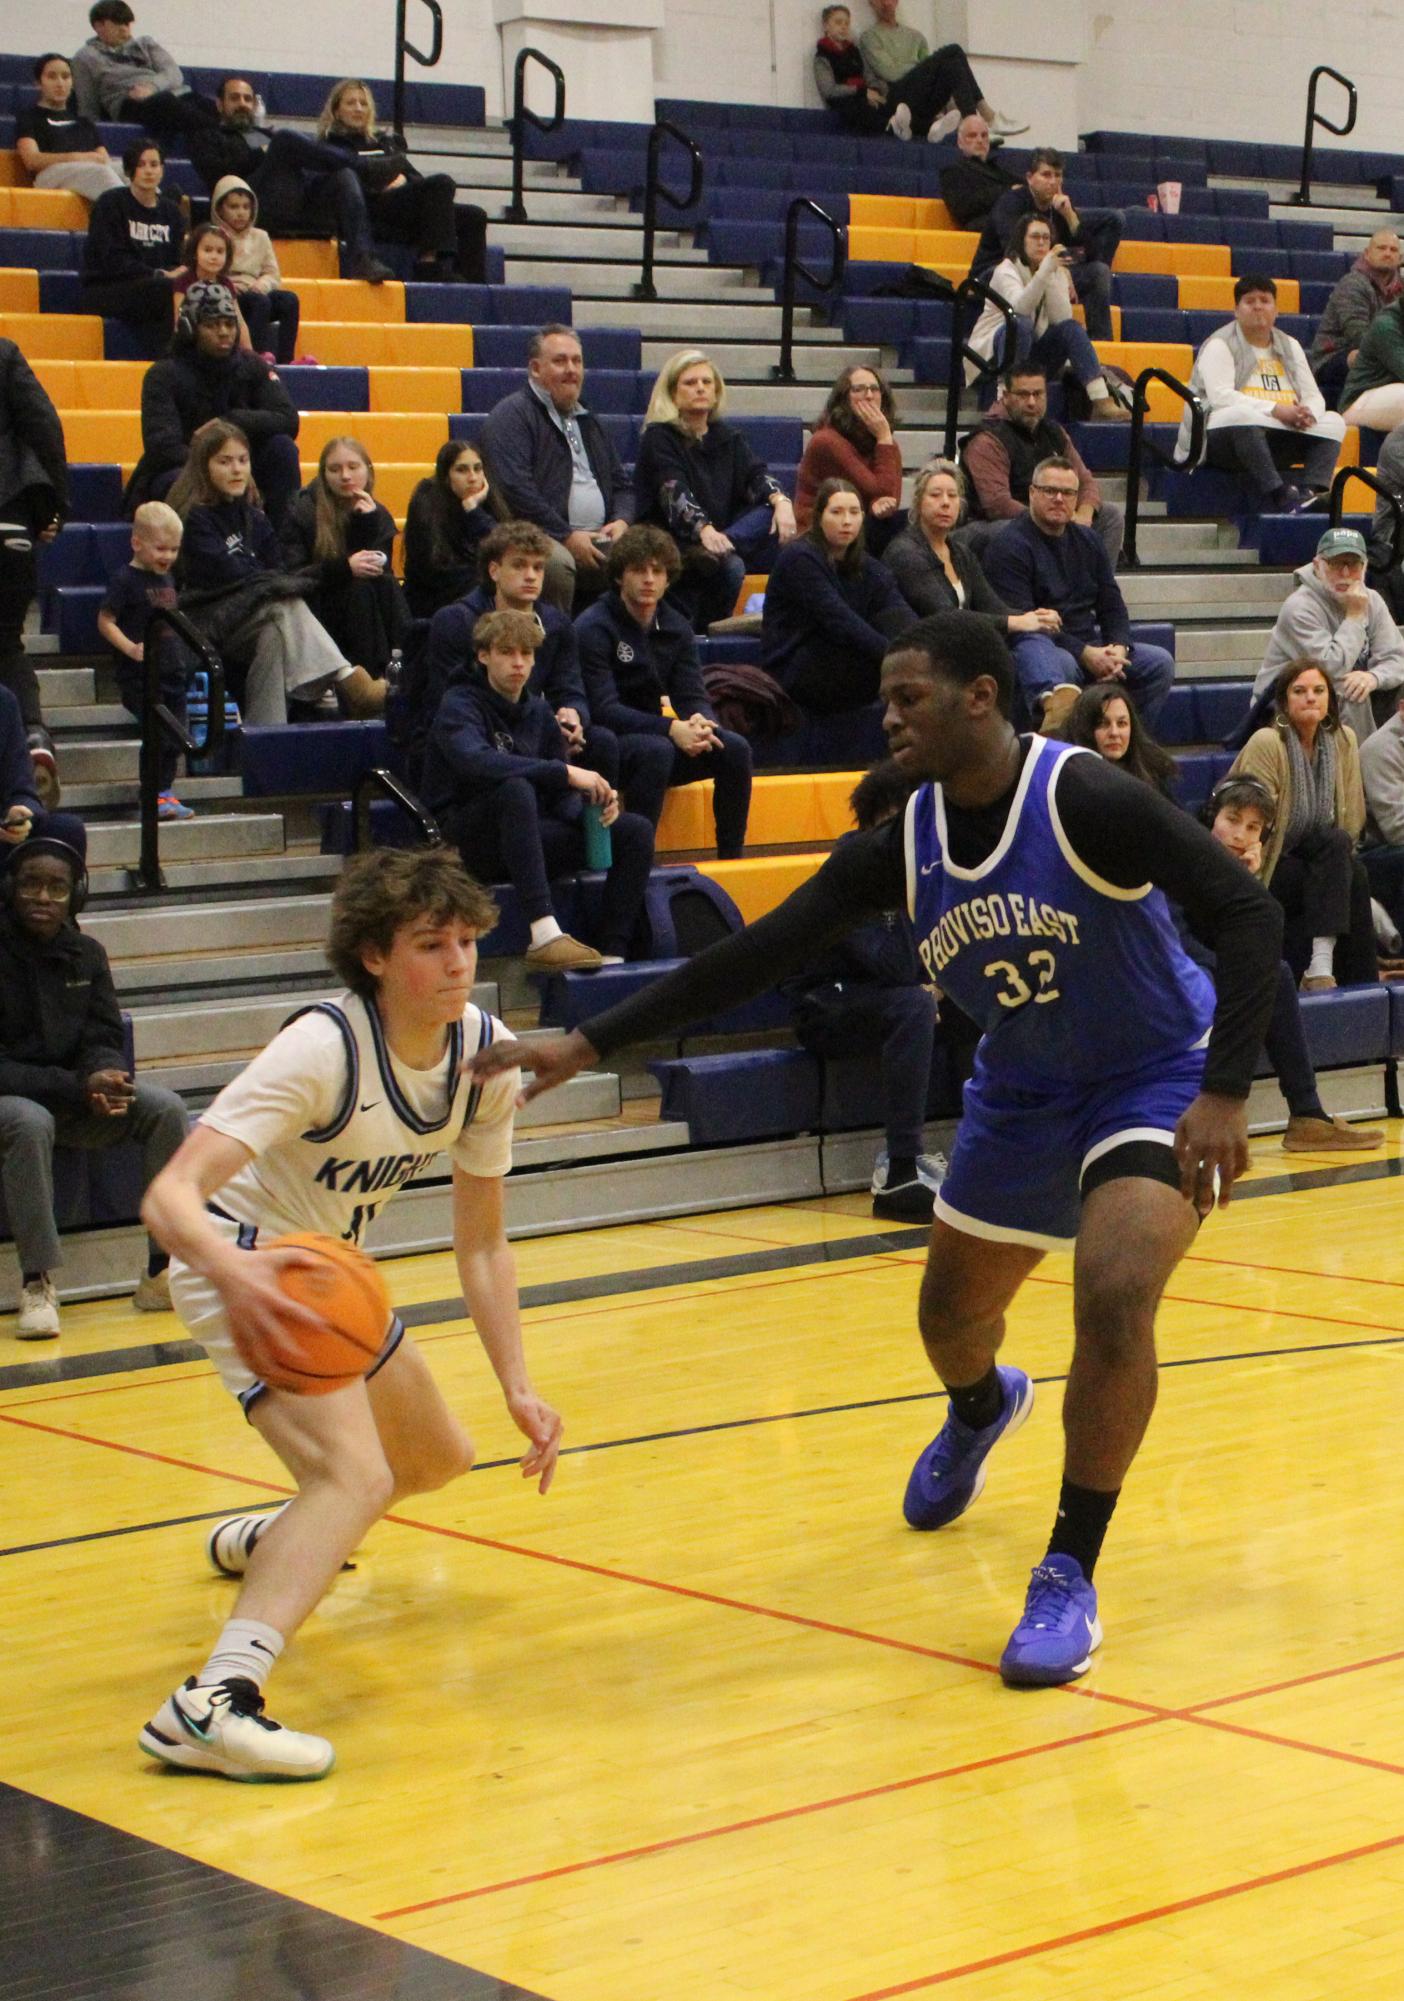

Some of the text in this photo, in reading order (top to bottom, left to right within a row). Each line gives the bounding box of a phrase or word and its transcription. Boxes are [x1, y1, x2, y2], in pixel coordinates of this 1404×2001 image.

[918, 893, 1080, 981] PROVISO EAST
[984, 950, 1060, 1008] 32
